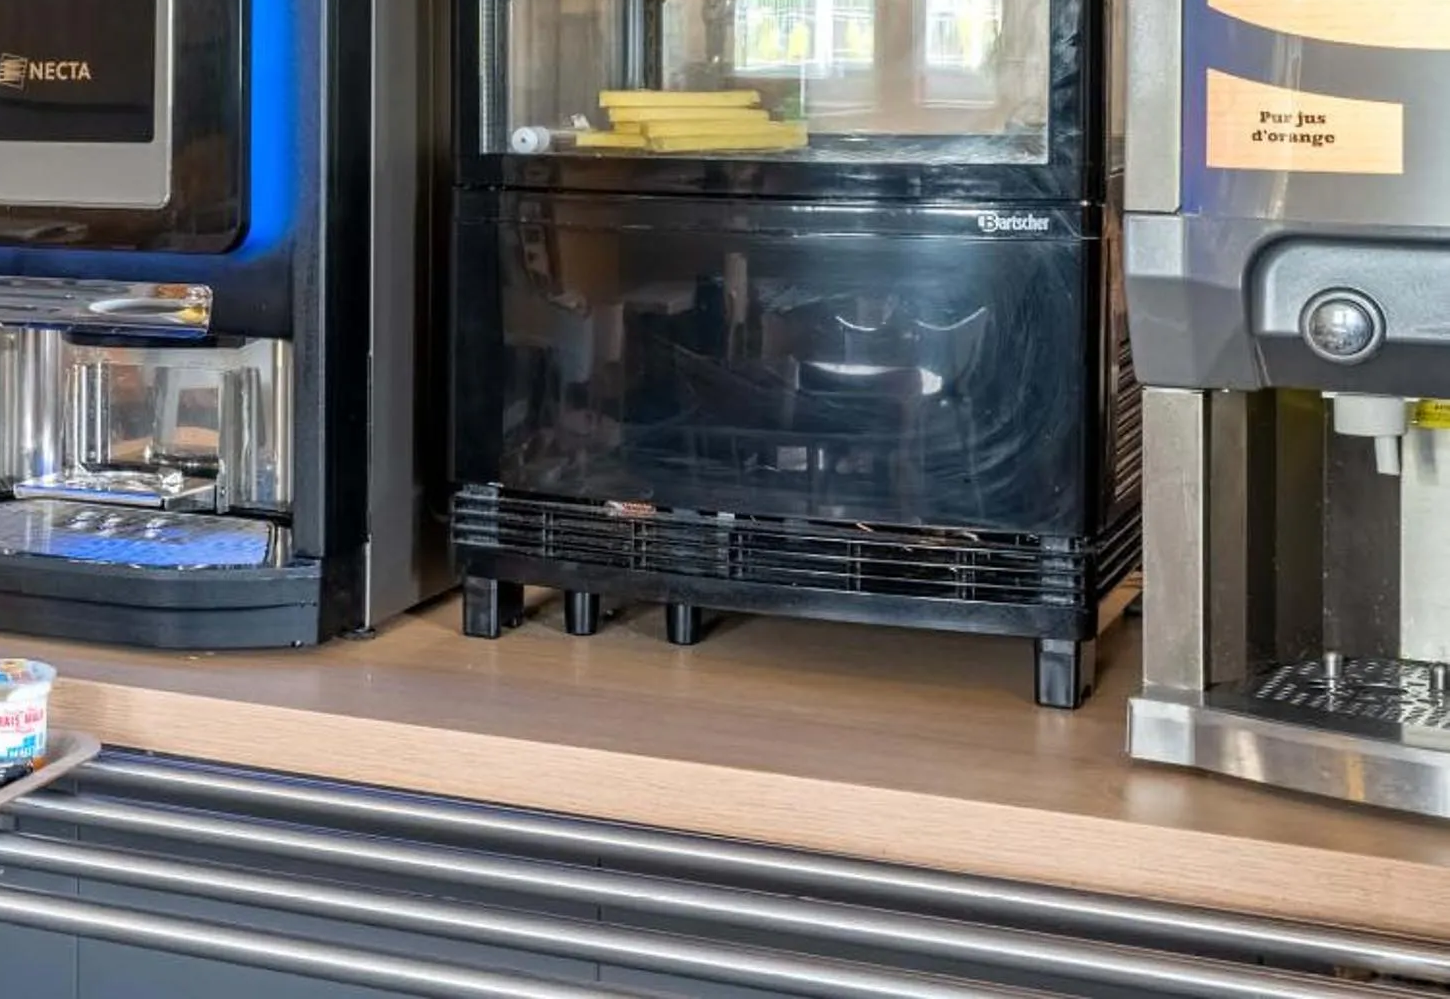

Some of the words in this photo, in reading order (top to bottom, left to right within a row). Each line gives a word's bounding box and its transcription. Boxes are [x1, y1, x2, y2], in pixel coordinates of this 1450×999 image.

[29, 61, 91, 80] NECTA
[1259, 110, 1292, 125] Pur
[1295, 110, 1326, 127] jus
[1251, 130, 1336, 147] d'orange
[978, 212, 1050, 233] Bartscher
